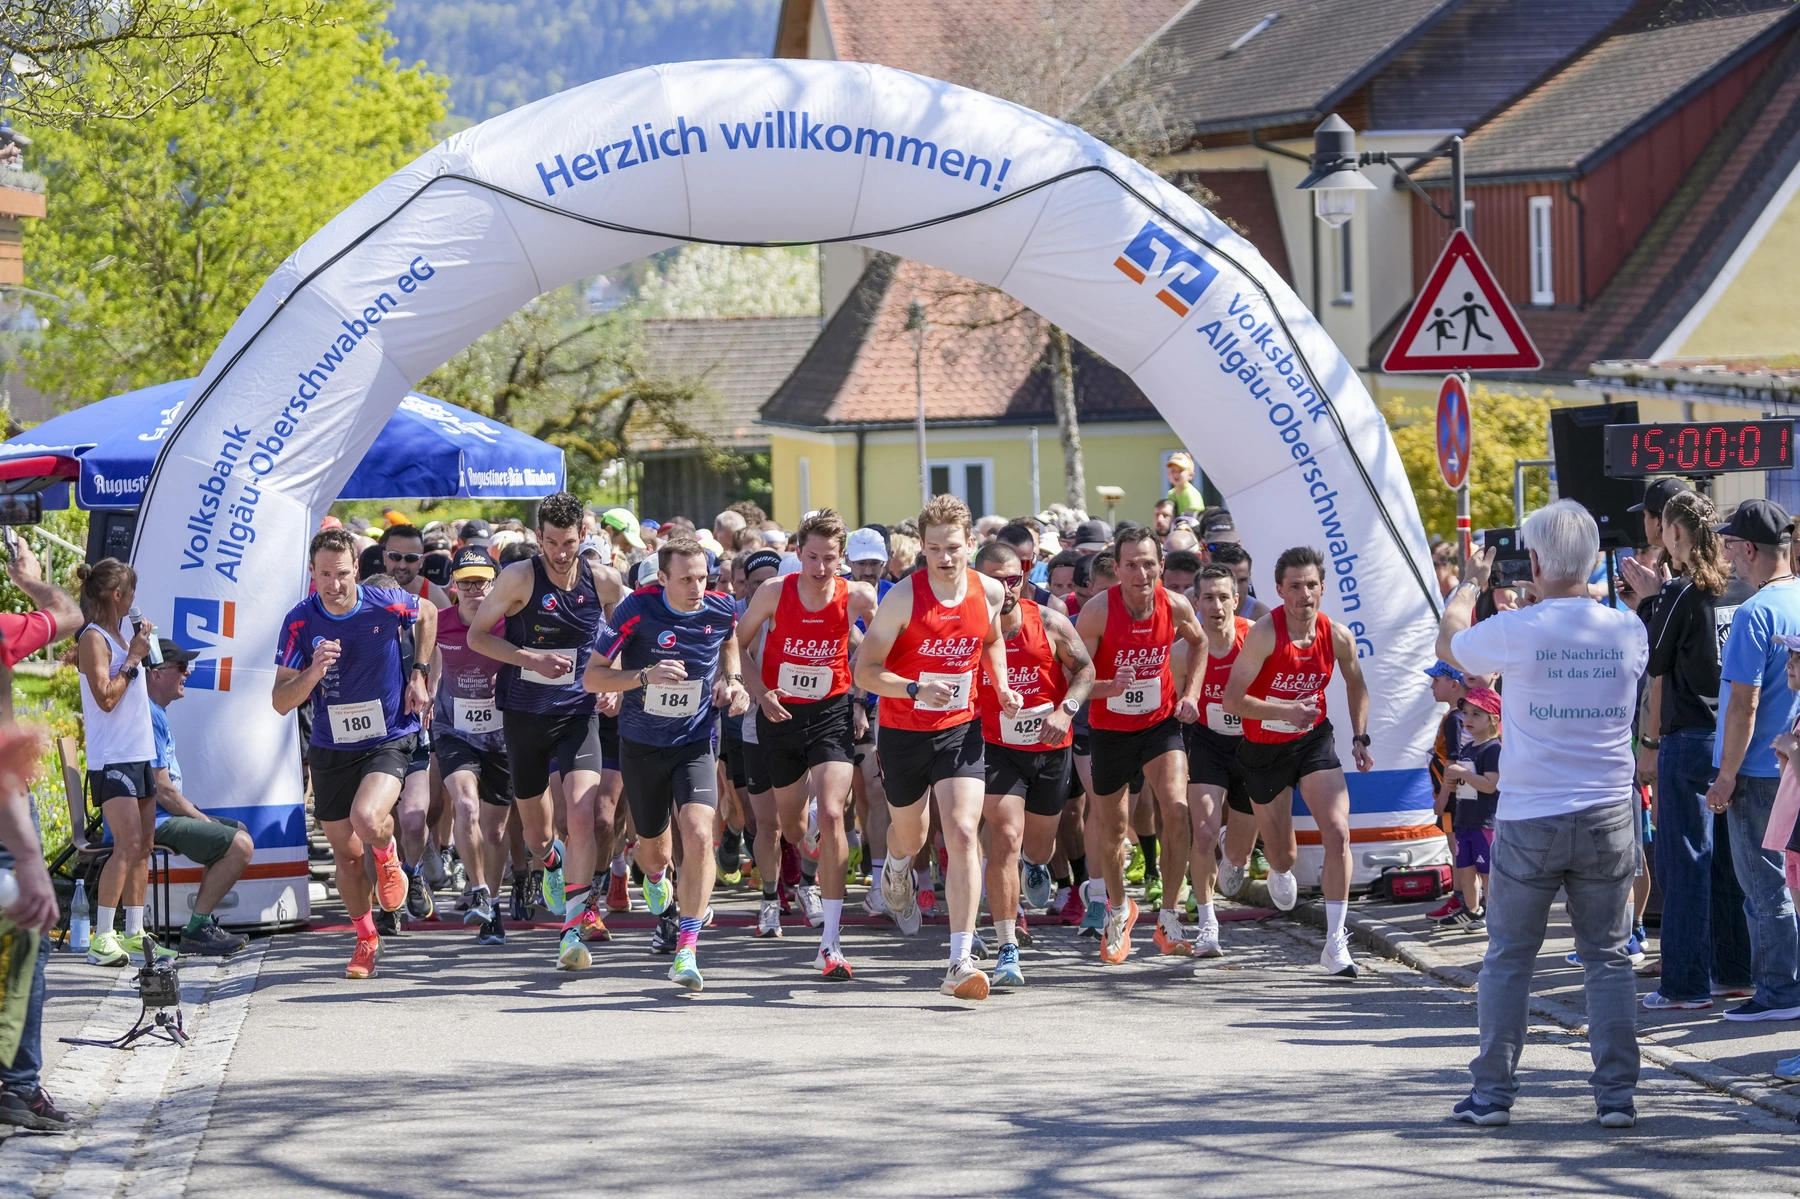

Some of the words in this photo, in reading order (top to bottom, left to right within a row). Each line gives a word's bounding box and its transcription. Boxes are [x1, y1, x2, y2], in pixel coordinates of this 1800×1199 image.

[536, 116, 707, 196] Herzlich
[719, 110, 1011, 192] willkommen!
[1228, 293, 1329, 423] Volksbank
[215, 292, 398, 583] Allgäu-Oberschwaben
[397, 255, 436, 294] eG
[1631, 425, 1788, 470] 15:00:01
[93, 474, 150, 497] Augusti
[1197, 320, 1362, 612] Allgäu-Oberschwaben
[1347, 620, 1375, 659] eG
[180, 424, 252, 571] Volksbank
[747, 555, 781, 570] DYNAFIT
[785, 637, 840, 649] SPORT
[922, 637, 979, 648] SPORT
[783, 644, 838, 657] HASCHKO
[918, 645, 975, 656] HASCHKO
[1116, 645, 1168, 658] SPORT
[1535, 650, 1557, 661] Die
[1561, 648, 1625, 660] Nachricht
[1114, 654, 1165, 666] HASCHKO
[1275, 672, 1327, 682] SPORT
[1548, 667, 1563, 679] ist
[1567, 667, 1589, 679] das
[1593, 667, 1617, 679] Ziel
[456, 676, 489, 684] Trollinger
[791, 674, 818, 688] 101
[1271, 679, 1322, 691] HASCHKO
[660, 693, 689, 707] 184
[1125, 690, 1144, 703] 98
[465, 709, 492, 722] 426
[1529, 702, 1627, 720] kolumna.org
[342, 715, 372, 732] 180
[1014, 718, 1042, 734] 428
[1223, 713, 1242, 726] 99
